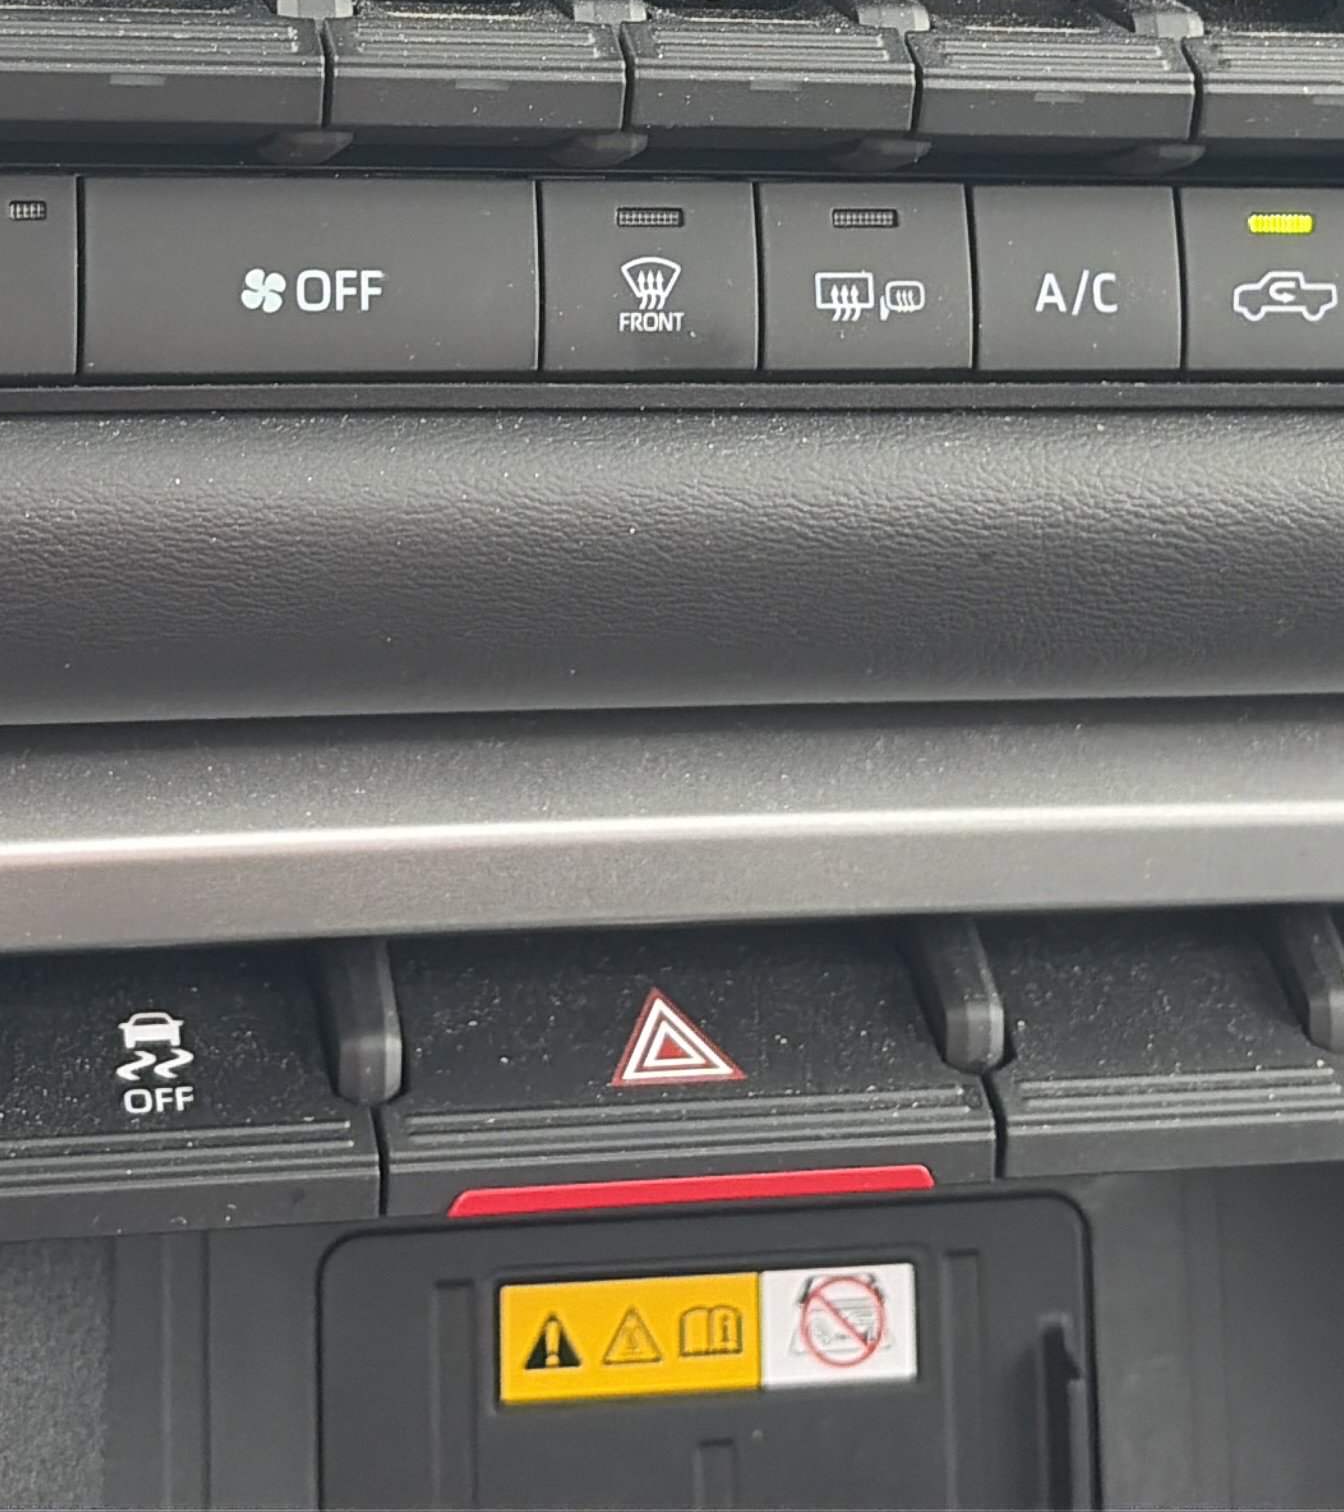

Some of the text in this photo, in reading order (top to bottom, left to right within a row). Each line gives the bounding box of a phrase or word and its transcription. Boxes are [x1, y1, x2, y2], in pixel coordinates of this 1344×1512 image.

[296, 269, 385, 312] OFF
[1035, 269, 1118, 316] A/C
[619, 311, 685, 332] FRONT
[123, 1086, 194, 1115] OFF
